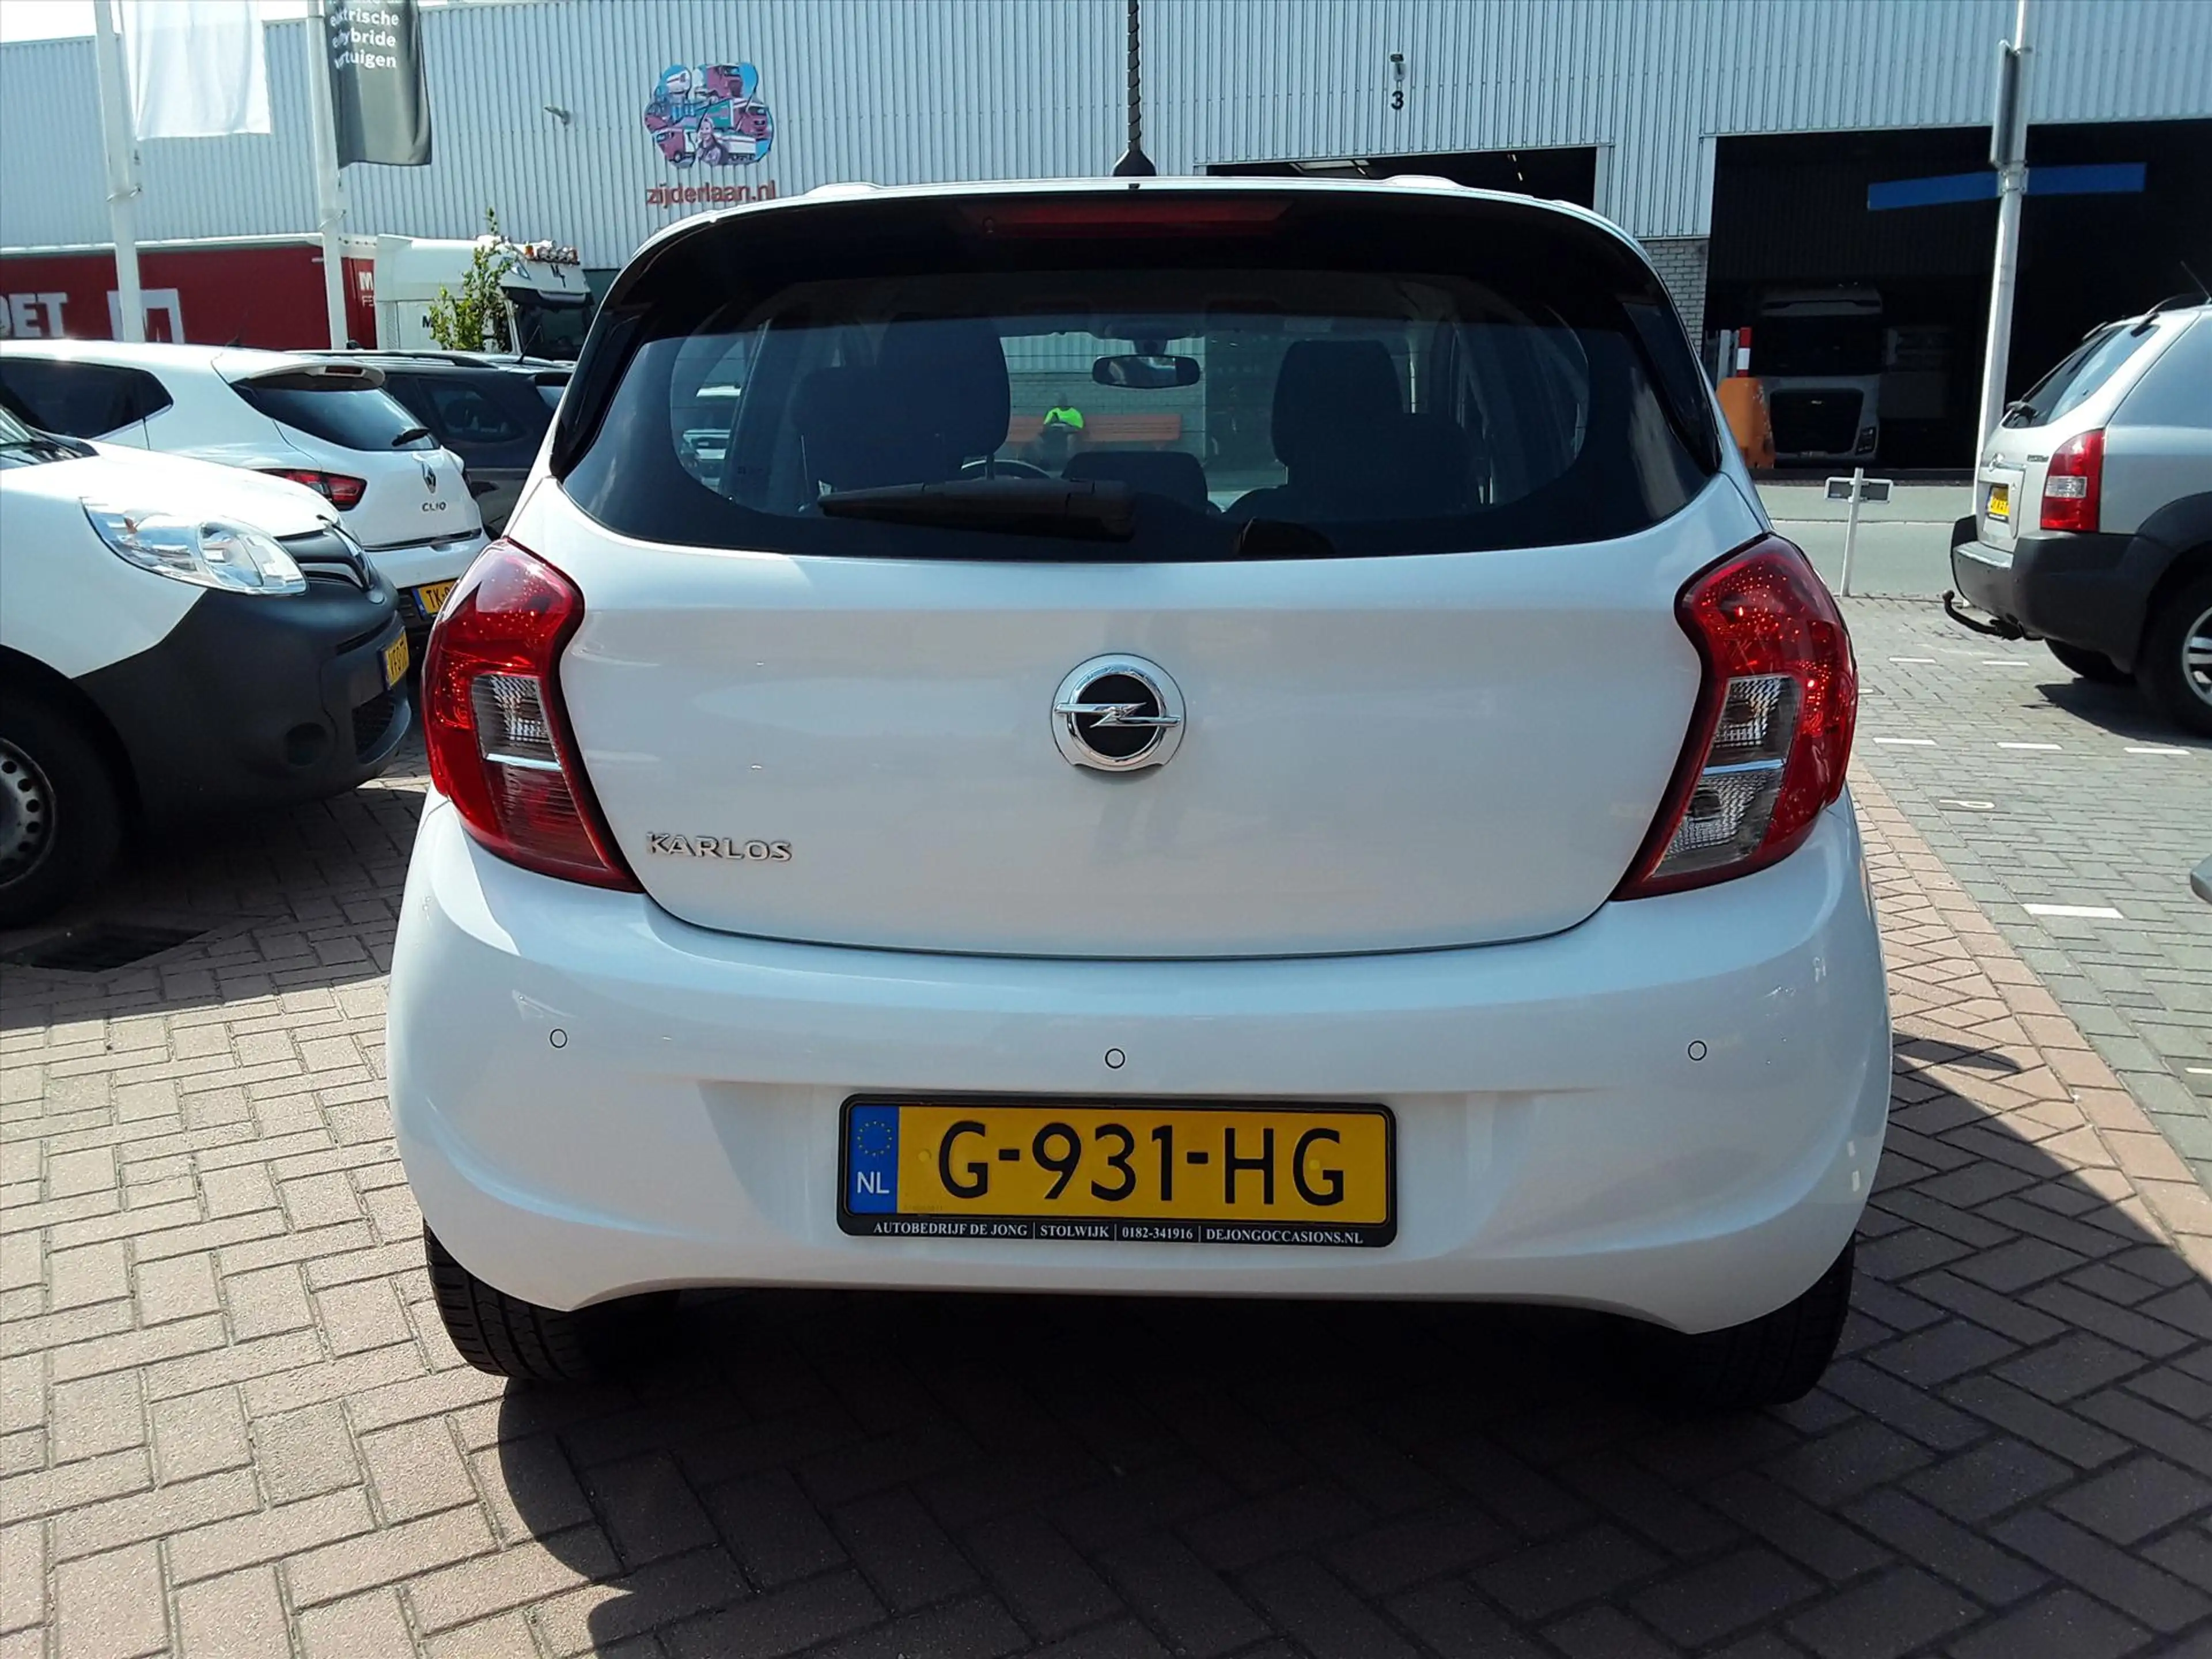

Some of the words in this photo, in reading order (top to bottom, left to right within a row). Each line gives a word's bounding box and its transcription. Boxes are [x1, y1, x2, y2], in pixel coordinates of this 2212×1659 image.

[1391, 90, 1404, 110] 3
[646, 179, 777, 209] zijderlaan.nl
[422, 501, 446, 512] CLIO
[646, 831, 792, 862] KARLOS
[938, 1120, 1344, 1206] G-931-HG
[857, 1171, 890, 1194] NL
[873, 1222, 967, 1236] AUTOBEDRIJF
[970, 1224, 987, 1236] DE
[991, 1224, 1028, 1237] JONG
[1040, 1225, 1110, 1238] STOLWIJK
[1122, 1227, 1193, 1240] 0182-341916
[1206, 1228, 1363, 1244] DEJONGOCCASIONS.NL
